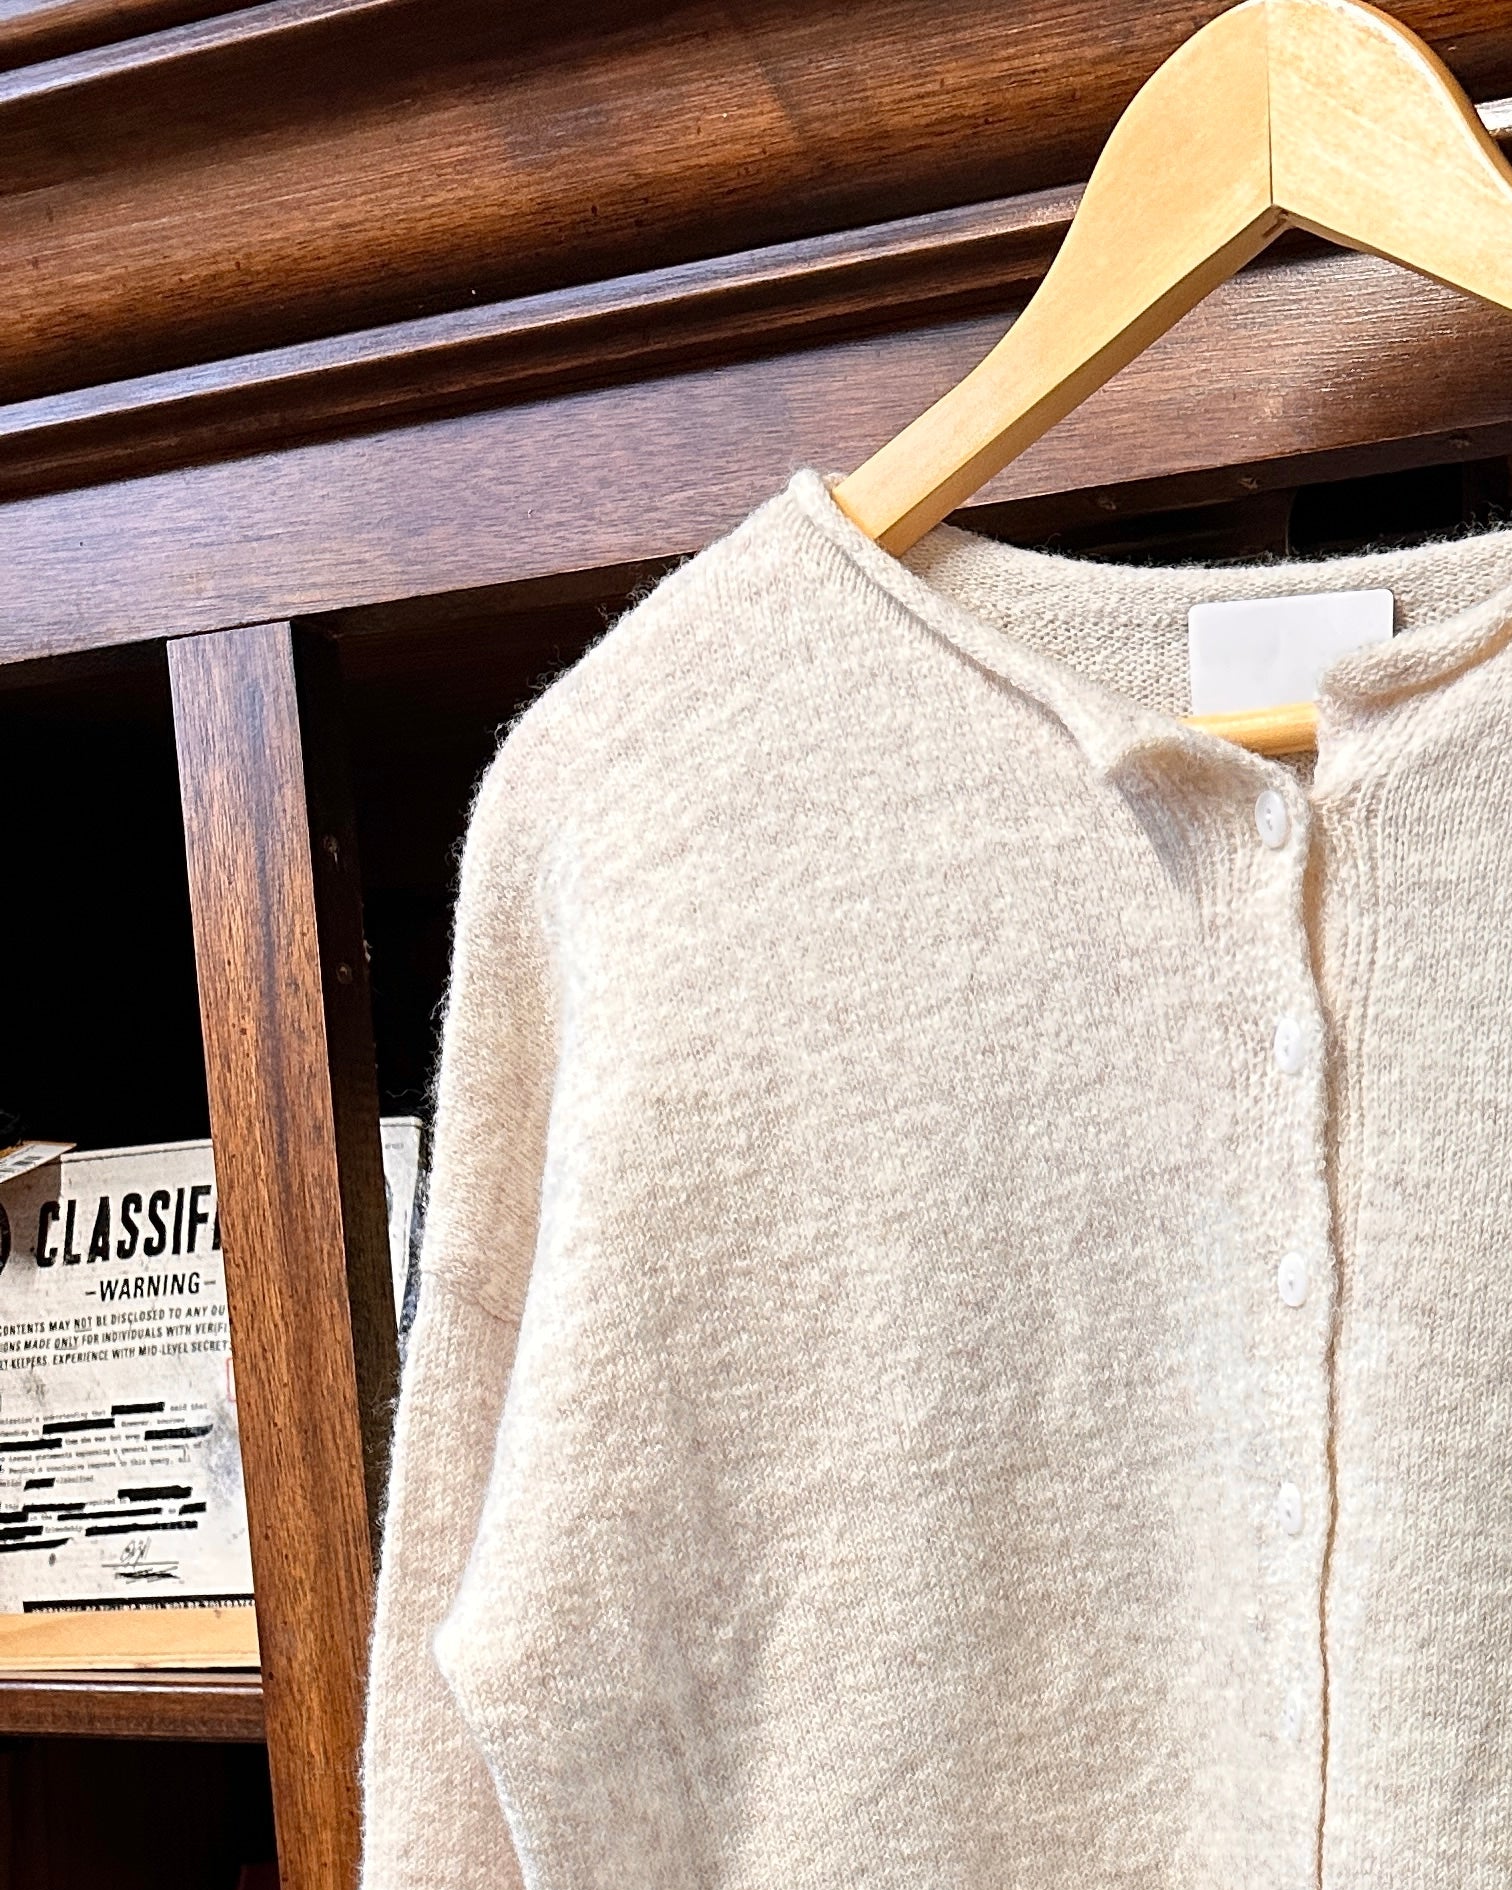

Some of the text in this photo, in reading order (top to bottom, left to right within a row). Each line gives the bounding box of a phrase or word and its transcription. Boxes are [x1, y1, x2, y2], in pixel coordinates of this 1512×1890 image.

[49, 1320, 70, 1332] MAY
[74, 1316, 92, 1331] NOT
[96, 1315, 108, 1327] BE
[111, 1308, 165, 1326] DISCLOSED
[169, 1308, 182, 1319] TO
[185, 1305, 208, 1318] ANY
[24, 1338, 50, 1350] MADE
[54, 1335, 79, 1350] ONLY
[82, 1334, 99, 1345] FOR
[102, 1326, 162, 1343] INDIVIDUALS
[166, 1323, 191, 1336] WITH
[53, 1350, 108, 1365] EXPERIENCE
[112, 1347, 135, 1359] WITH
